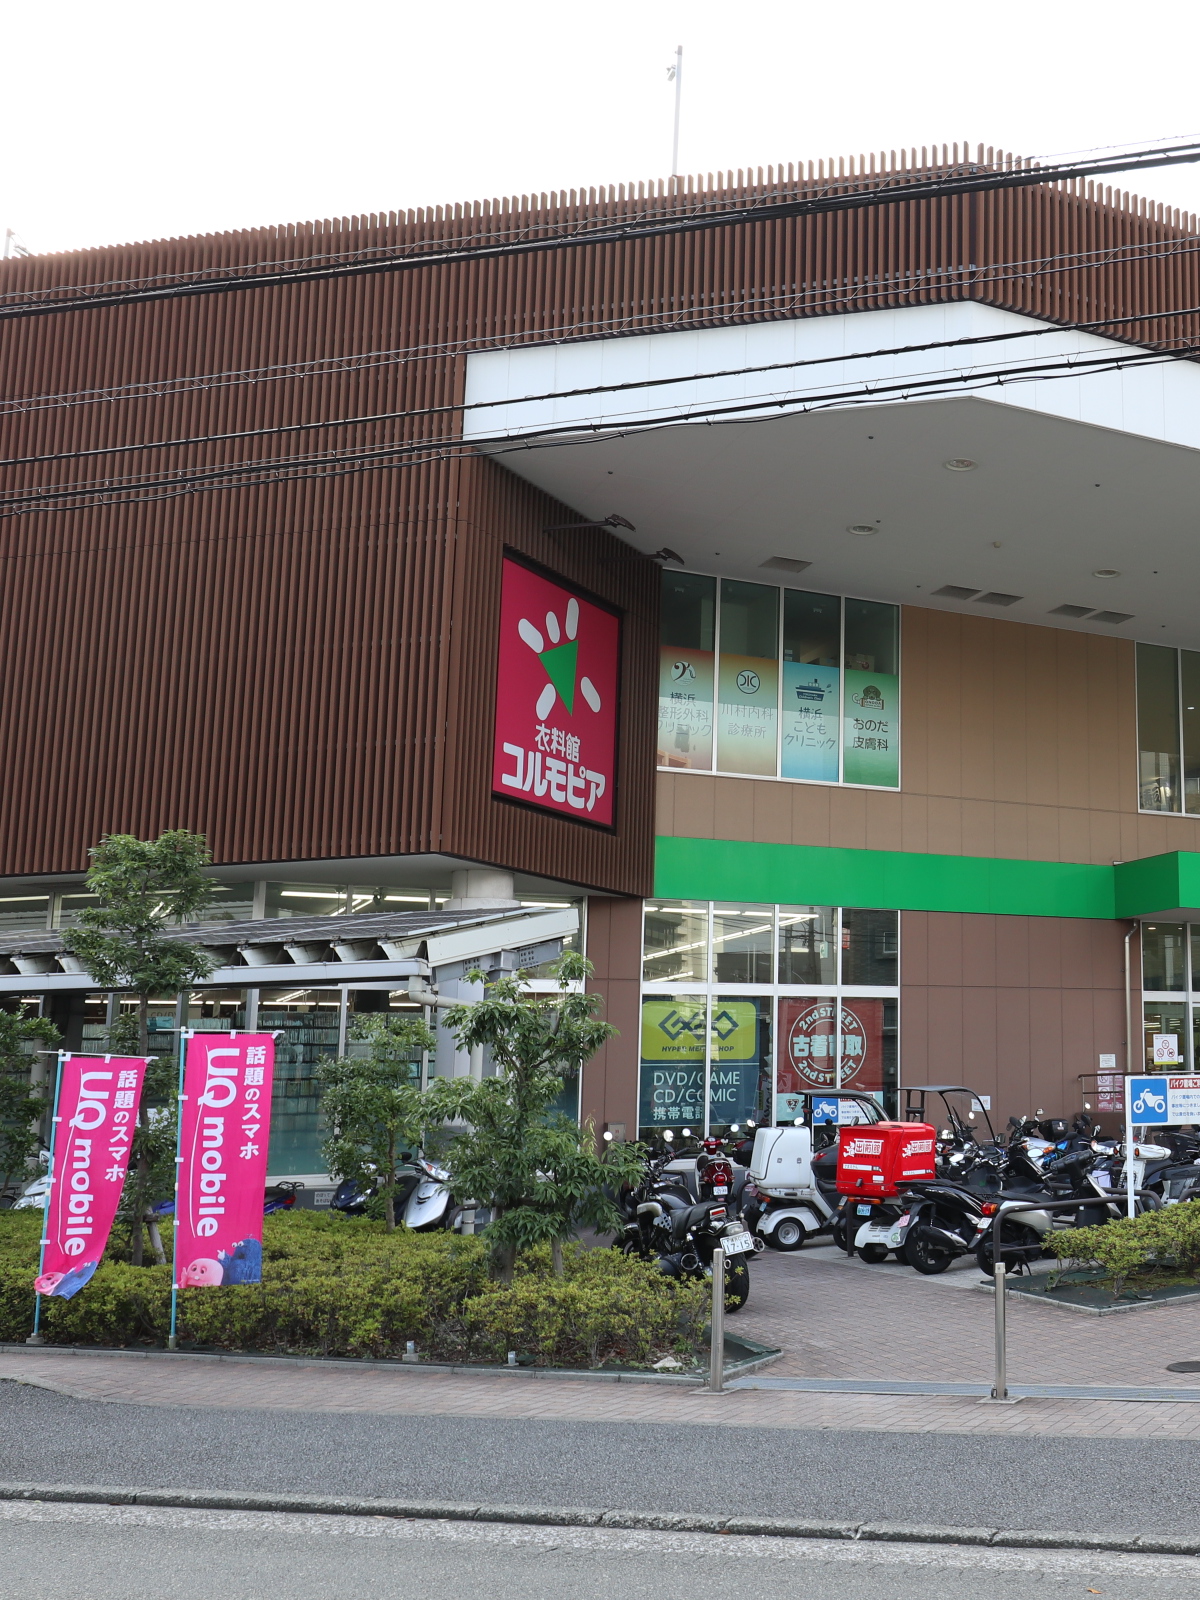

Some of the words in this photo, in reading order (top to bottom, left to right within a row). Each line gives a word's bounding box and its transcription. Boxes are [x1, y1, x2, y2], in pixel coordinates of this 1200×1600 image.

[670, 692, 696, 707] 横浜
[722, 703, 773, 720] 川村内科
[799, 707, 822, 720] 横浜
[853, 718, 888, 733] おのだ
[728, 722, 766, 739] 診療所
[794, 721, 827, 735] こども
[535, 723, 580, 762] 衣料館
[784, 733, 836, 749] クリニック
[852, 736, 888, 751] 皮膚科
[501, 742, 605, 812] コルモピア
[798, 1009, 820, 1031] 2nd
[819, 1006, 859, 1031] STEET
[793, 1034, 863, 1057] 古着買取
[198, 1047, 240, 1109] UQ
[798, 1060, 819, 1080] 2nd
[818, 1059, 857, 1083] STEET
[69, 1071, 113, 1131] UQ
[239, 1045, 266, 1160] 話題のスマホ
[104, 1069, 138, 1182] 話題のスマホ
[197, 1116, 227, 1237] mobile
[64, 1138, 94, 1256] mobile
